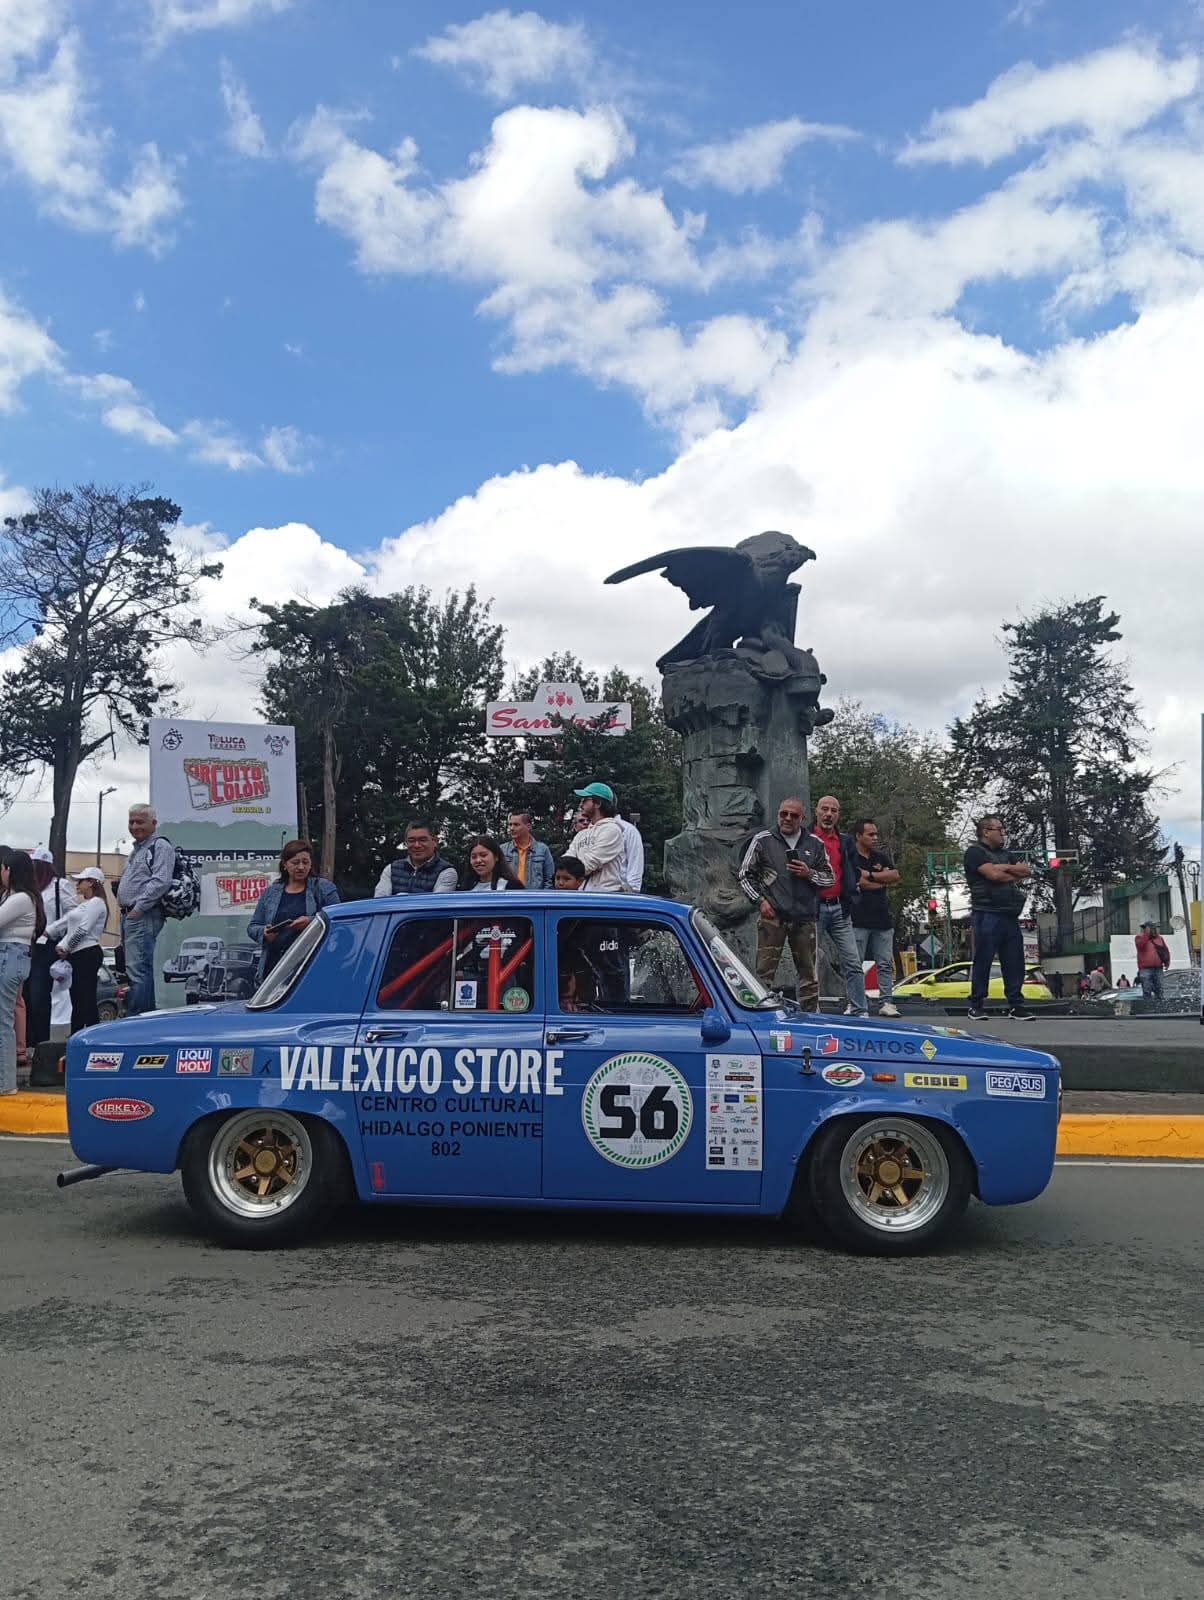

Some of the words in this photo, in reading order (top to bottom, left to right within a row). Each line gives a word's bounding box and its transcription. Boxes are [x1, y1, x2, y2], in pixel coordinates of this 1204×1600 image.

[208, 734, 246, 744] TOLUCA
[215, 852, 231, 861] de
[233, 852, 244, 861] la
[843, 1038, 916, 1055] SIATOS
[180, 1050, 210, 1060] LIQUI
[178, 1060, 210, 1072] MOLY
[279, 1046, 442, 1095] VALEXICO
[452, 1048, 565, 1096] STORE
[990, 1075, 1042, 1091] PEGASUS
[96, 1103, 139, 1113] KIRKEY
[361, 1096, 438, 1113] CENTRO
[445, 1097, 543, 1114] CULTURAL
[599, 1085, 679, 1140] 56
[361, 1120, 445, 1137] HIDALGO
[451, 1121, 543, 1138] PONIENTE
[430, 1141, 461, 1156] 802
